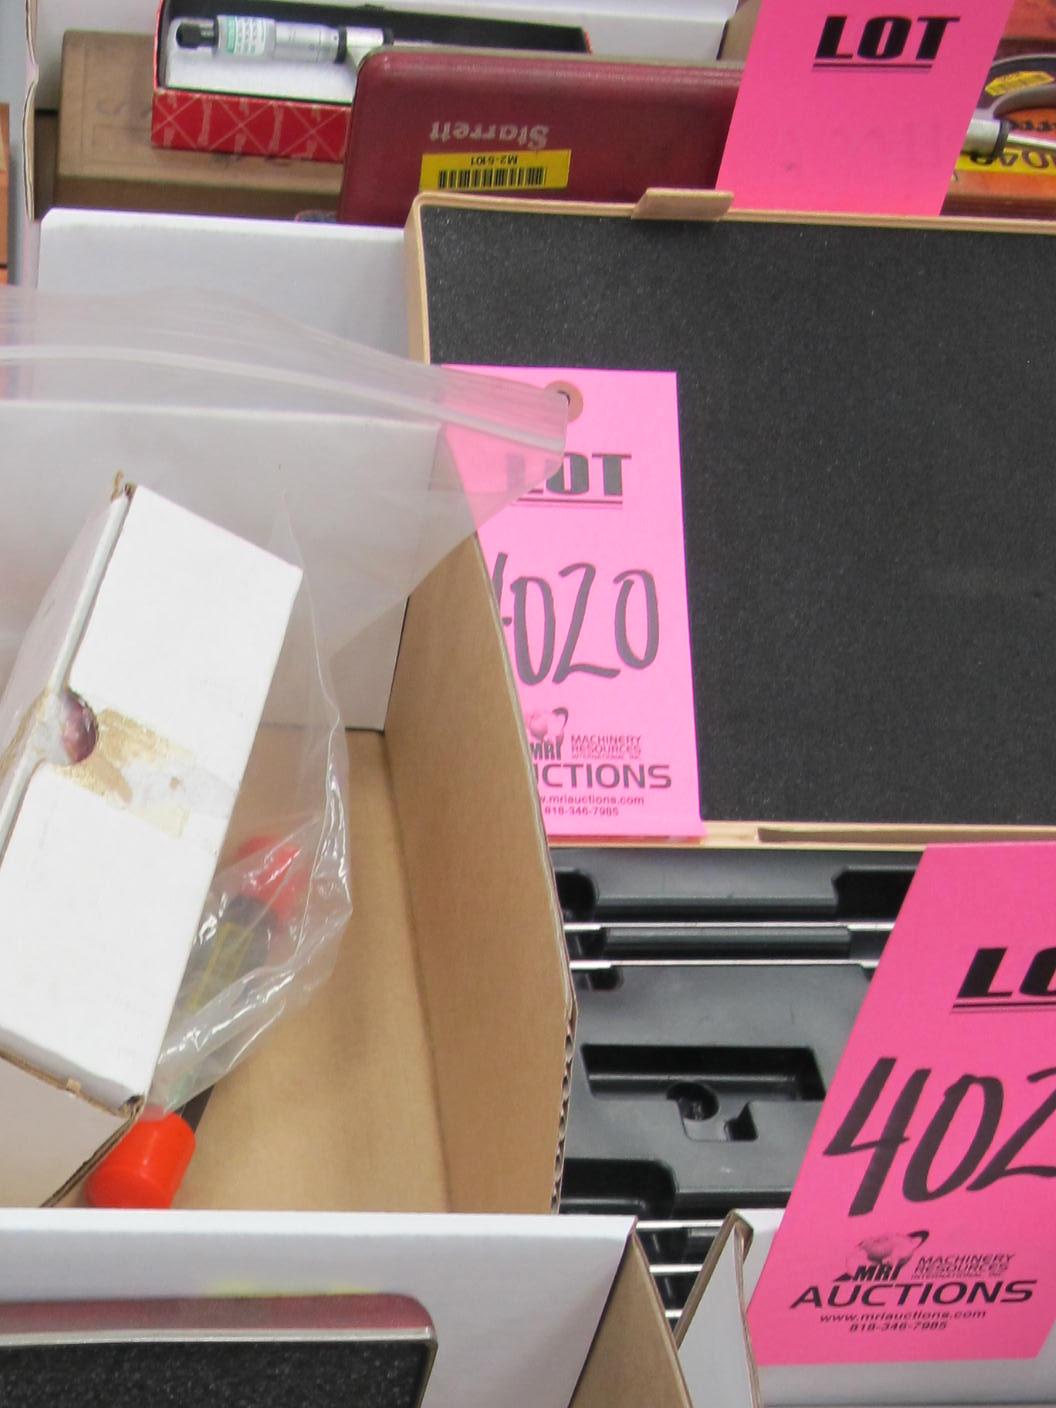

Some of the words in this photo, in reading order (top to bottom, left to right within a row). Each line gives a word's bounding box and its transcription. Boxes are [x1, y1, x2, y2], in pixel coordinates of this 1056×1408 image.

[815, 15, 961, 61] LOT
[429, 121, 549, 151] Starrett
[571, 735, 642, 745] MACHINERY
[534, 763, 672, 789] CTIONS
[823, 1056, 1056, 1217] 402
[919, 1253, 1015, 1265] MACHINERY
[789, 1279, 1038, 1310] AUCTIONS
[819, 1310, 986, 1323] www.mriauctions.com
